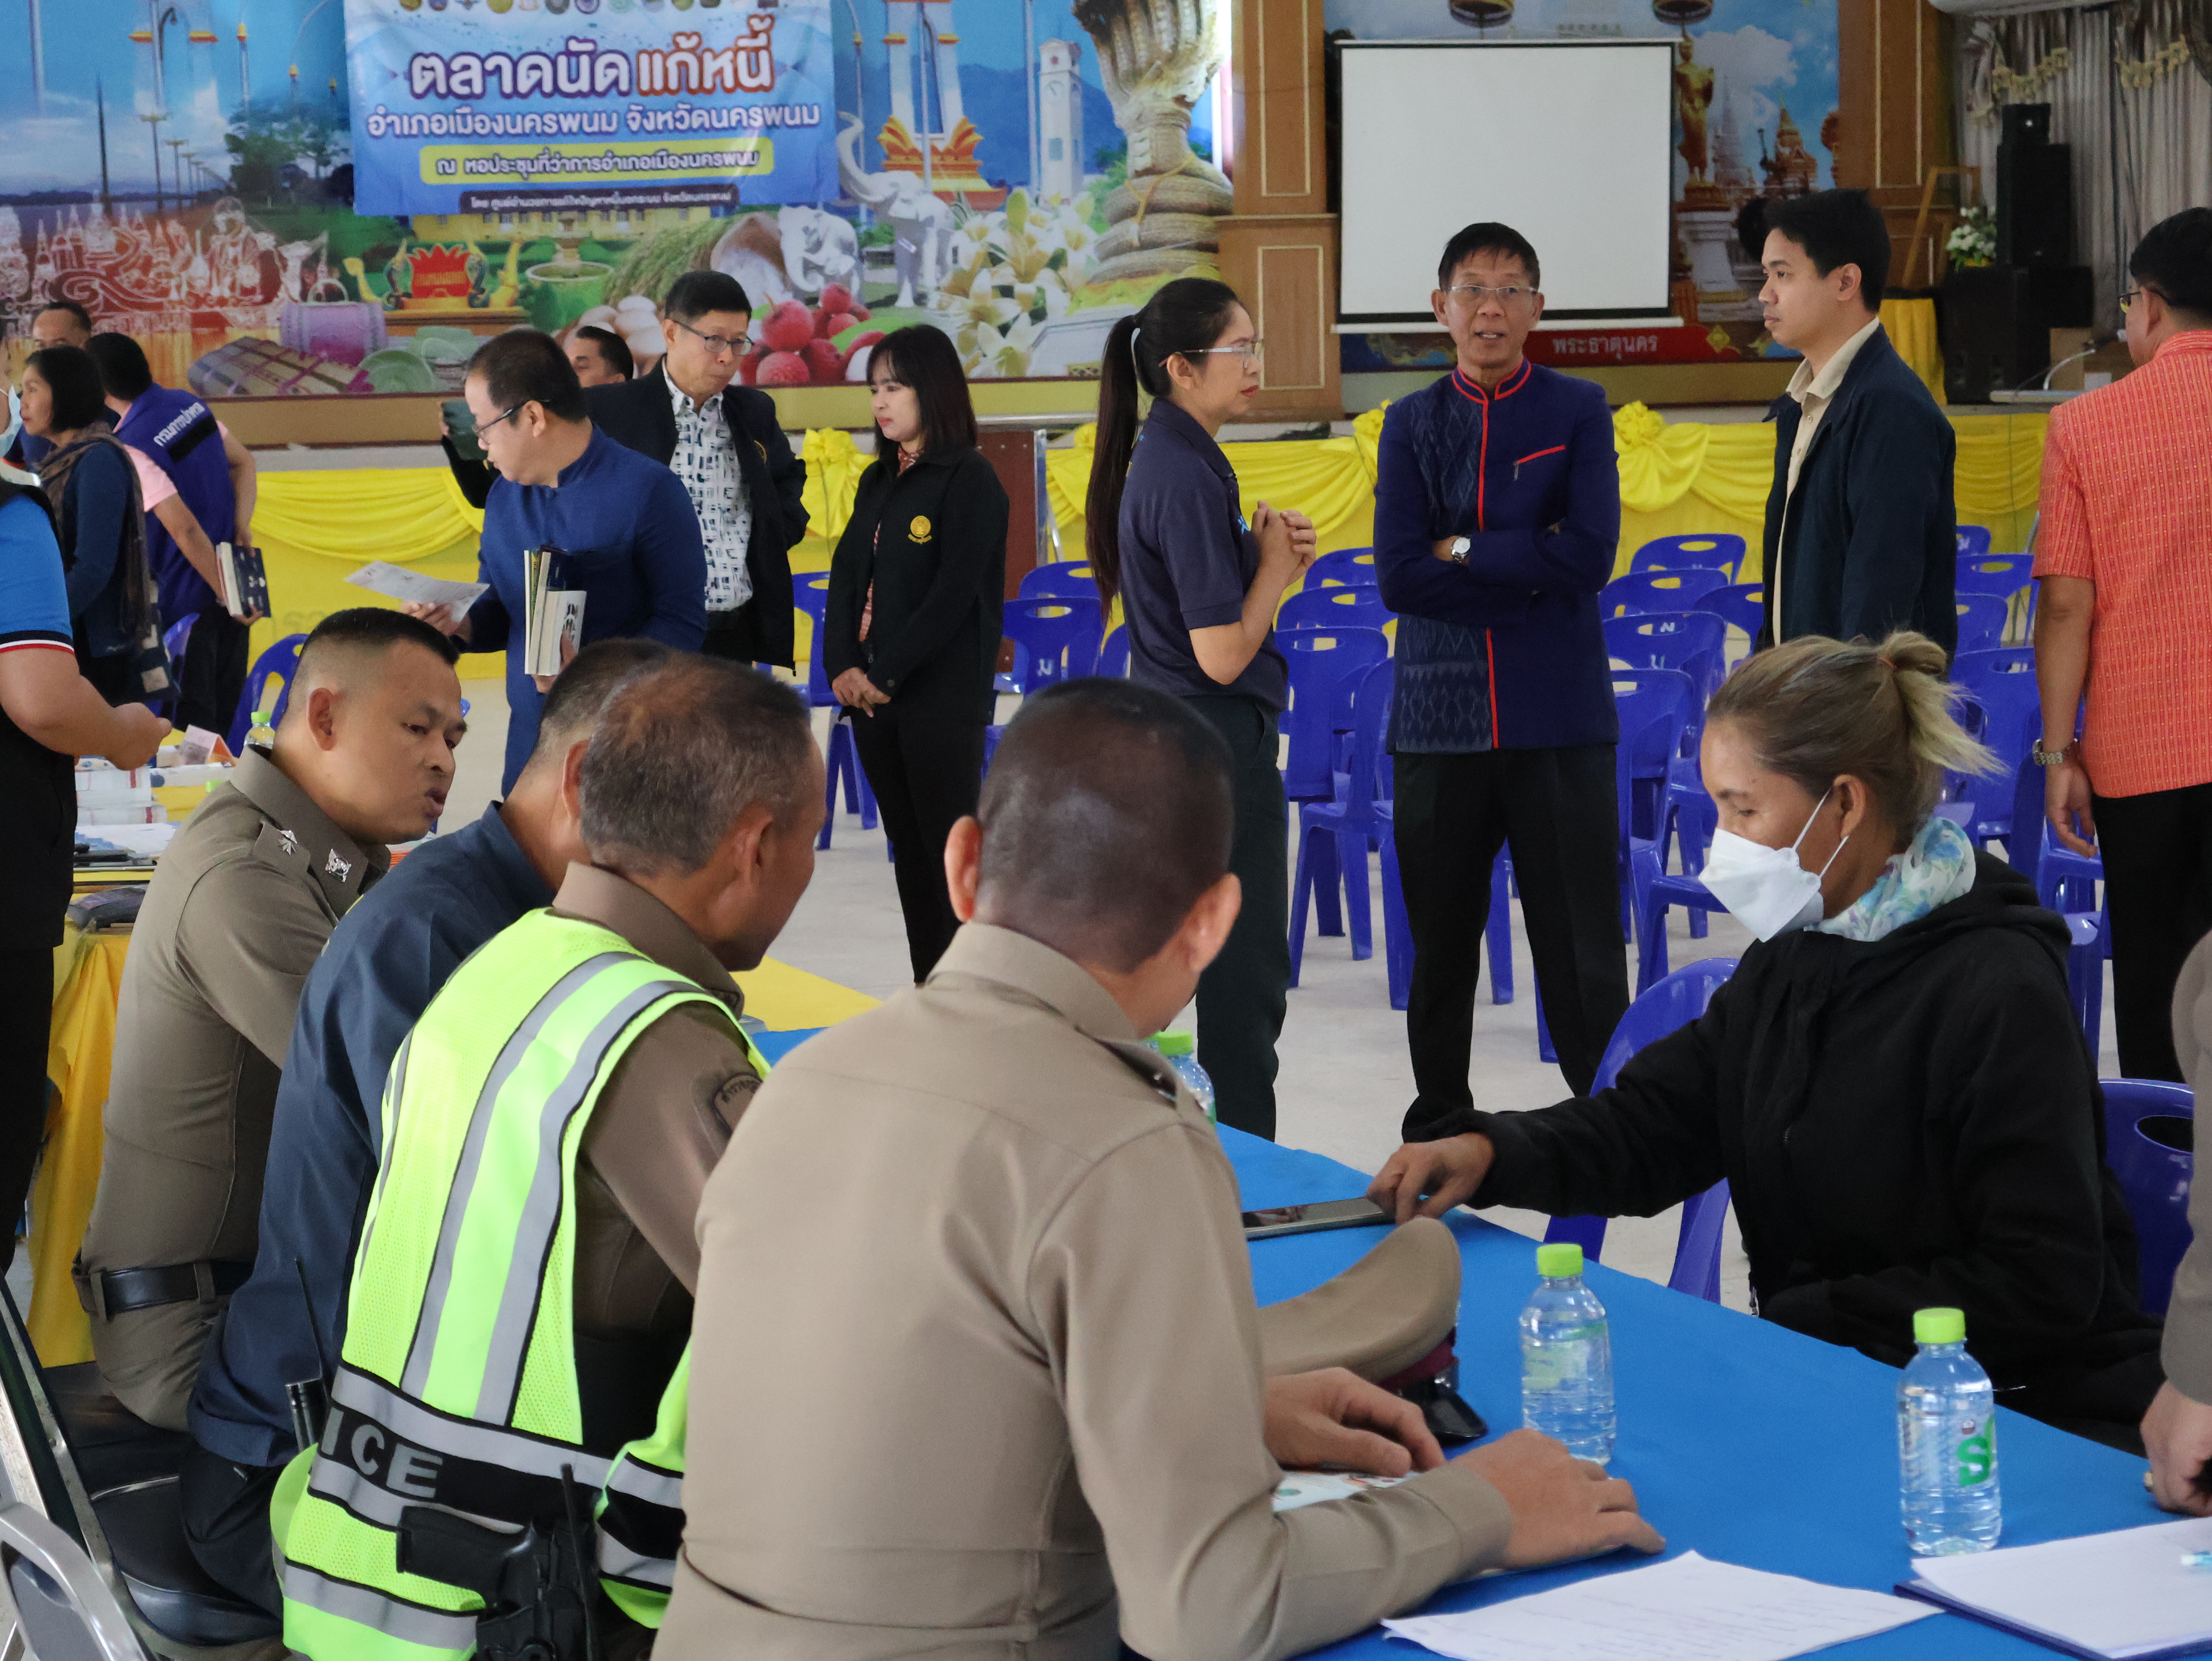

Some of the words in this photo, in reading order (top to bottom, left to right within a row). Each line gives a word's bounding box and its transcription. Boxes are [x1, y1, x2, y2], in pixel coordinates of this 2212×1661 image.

[367, 104, 618, 137] อำเภอเมืองนครพนม
[626, 102, 820, 132] จังหวัดนครพนม
[437, 158, 456, 174] ณ
[464, 147, 760, 179] หอประชุมที่ว่าการอำเภอเมืองนครพนม
